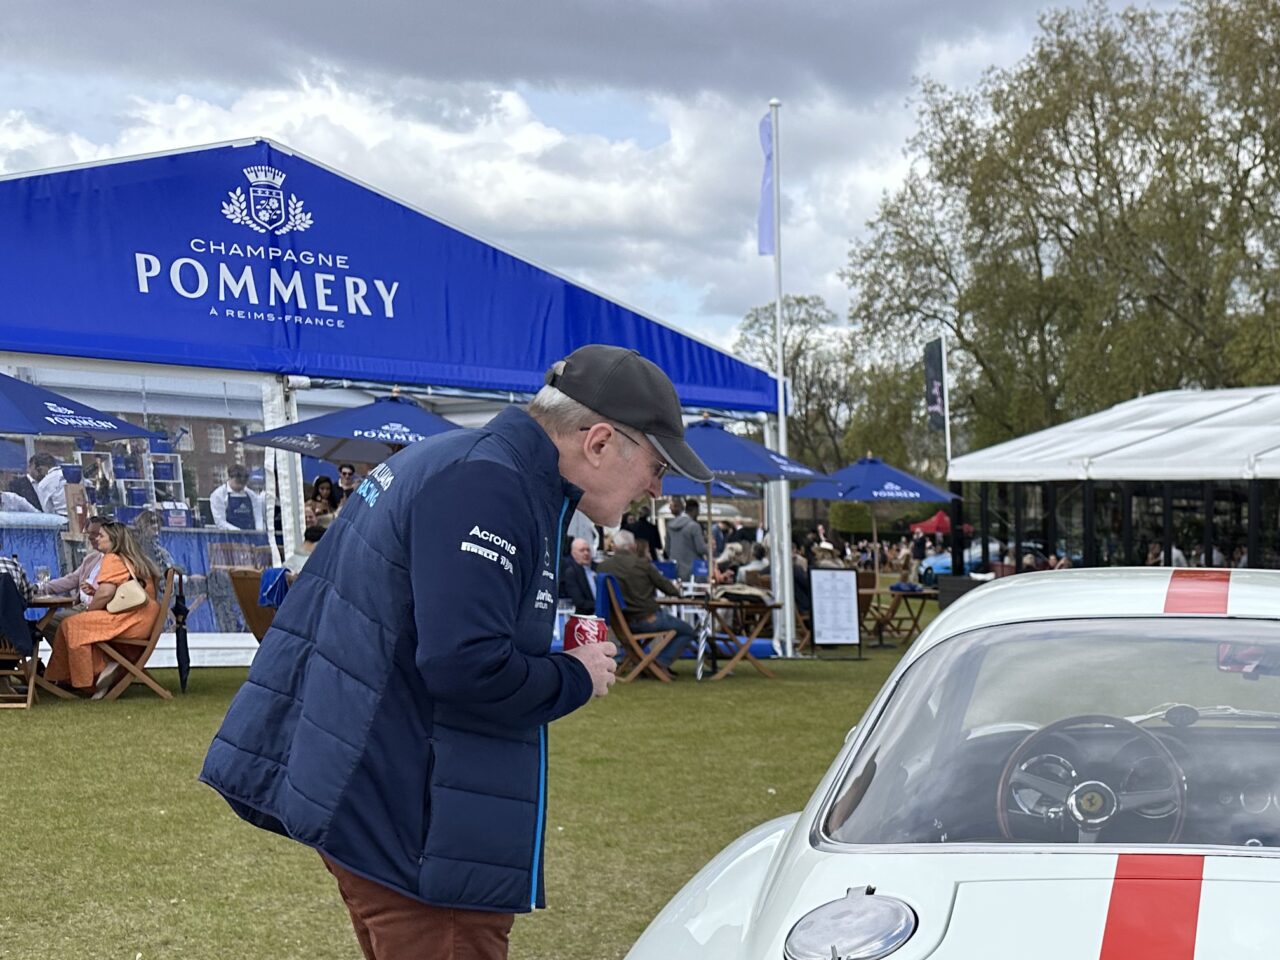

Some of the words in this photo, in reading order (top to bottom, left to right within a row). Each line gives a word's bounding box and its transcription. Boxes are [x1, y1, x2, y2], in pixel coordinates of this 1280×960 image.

[190, 239, 350, 269] CHAMPAGNE
[135, 252, 400, 318] POMMERY
[225, 309, 345, 328] REIMS-FRANCE
[353, 430, 426, 443] POMMER
[469, 525, 517, 555] Acronis
